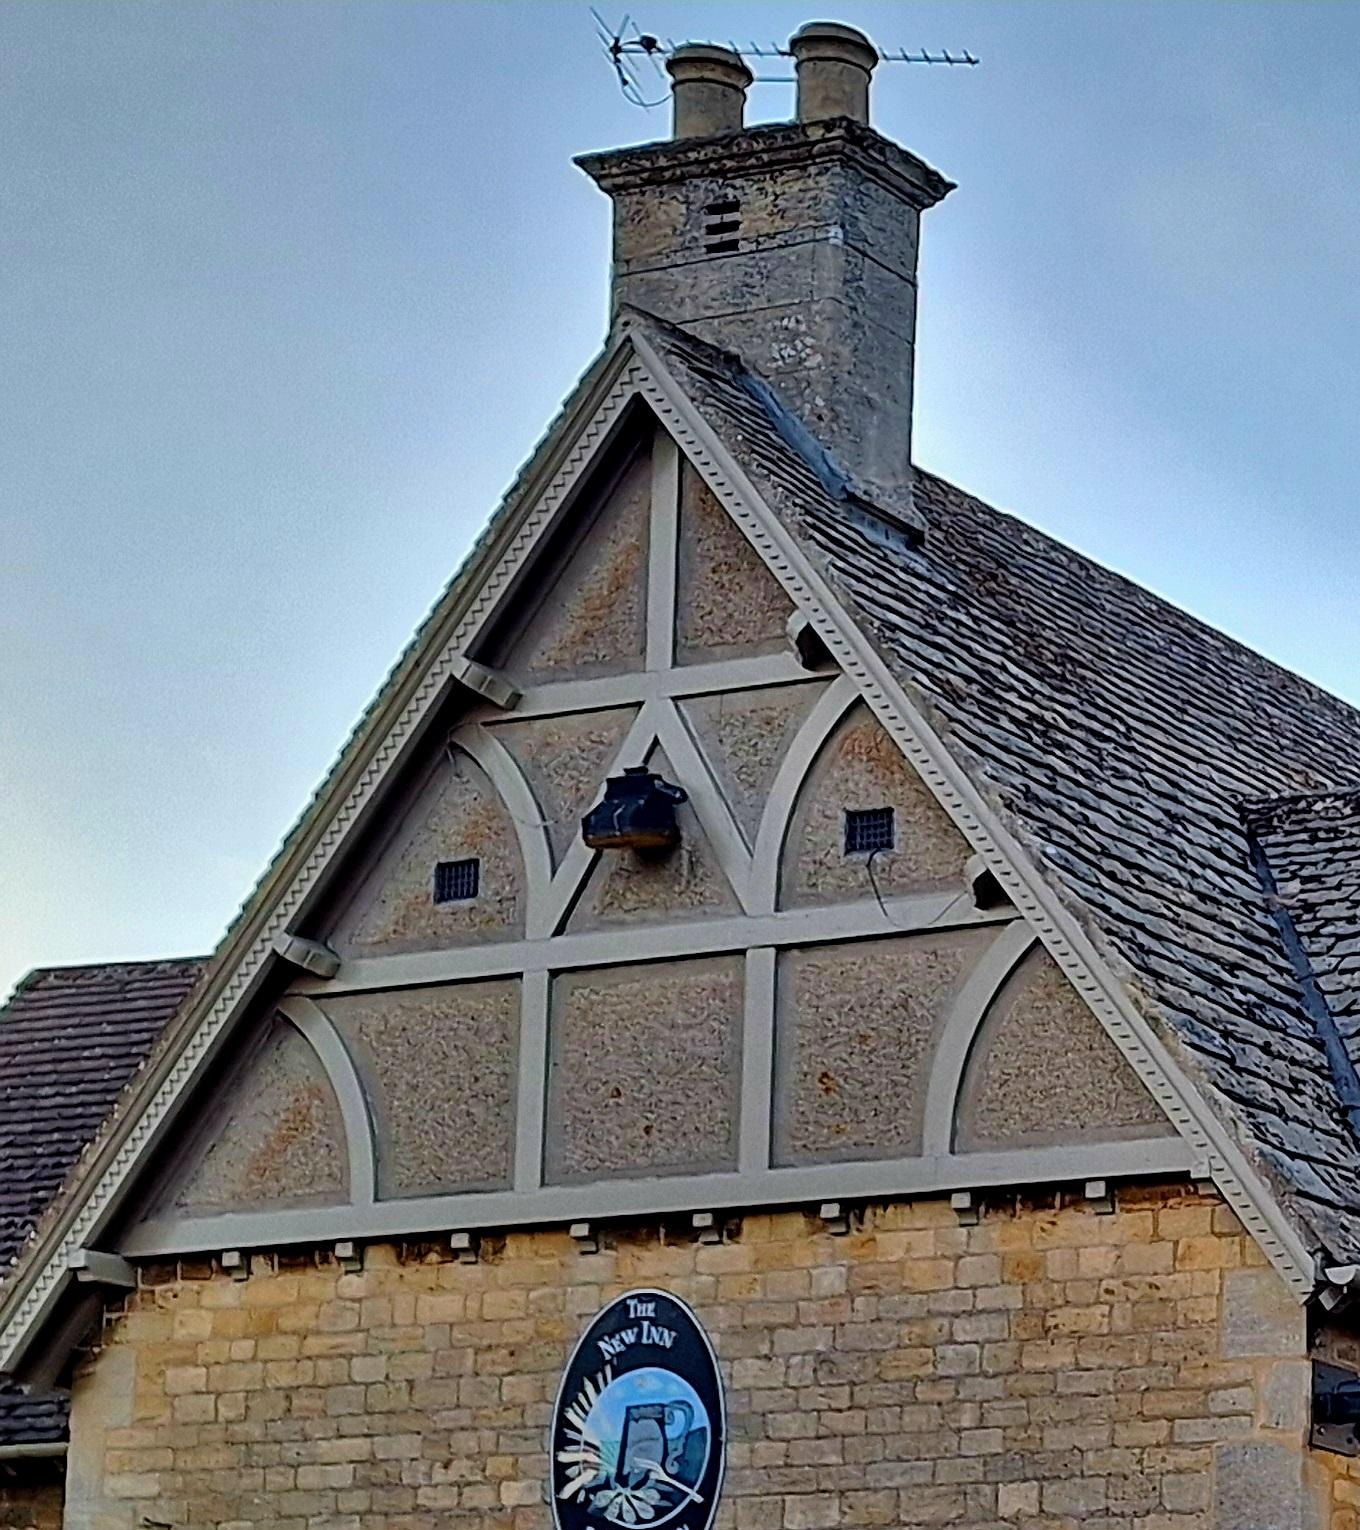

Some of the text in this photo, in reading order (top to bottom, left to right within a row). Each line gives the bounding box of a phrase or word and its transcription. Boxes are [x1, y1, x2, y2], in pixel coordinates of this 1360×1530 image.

[626, 1298, 656, 1318] THE
[597, 1320, 678, 1360] NEW INN
